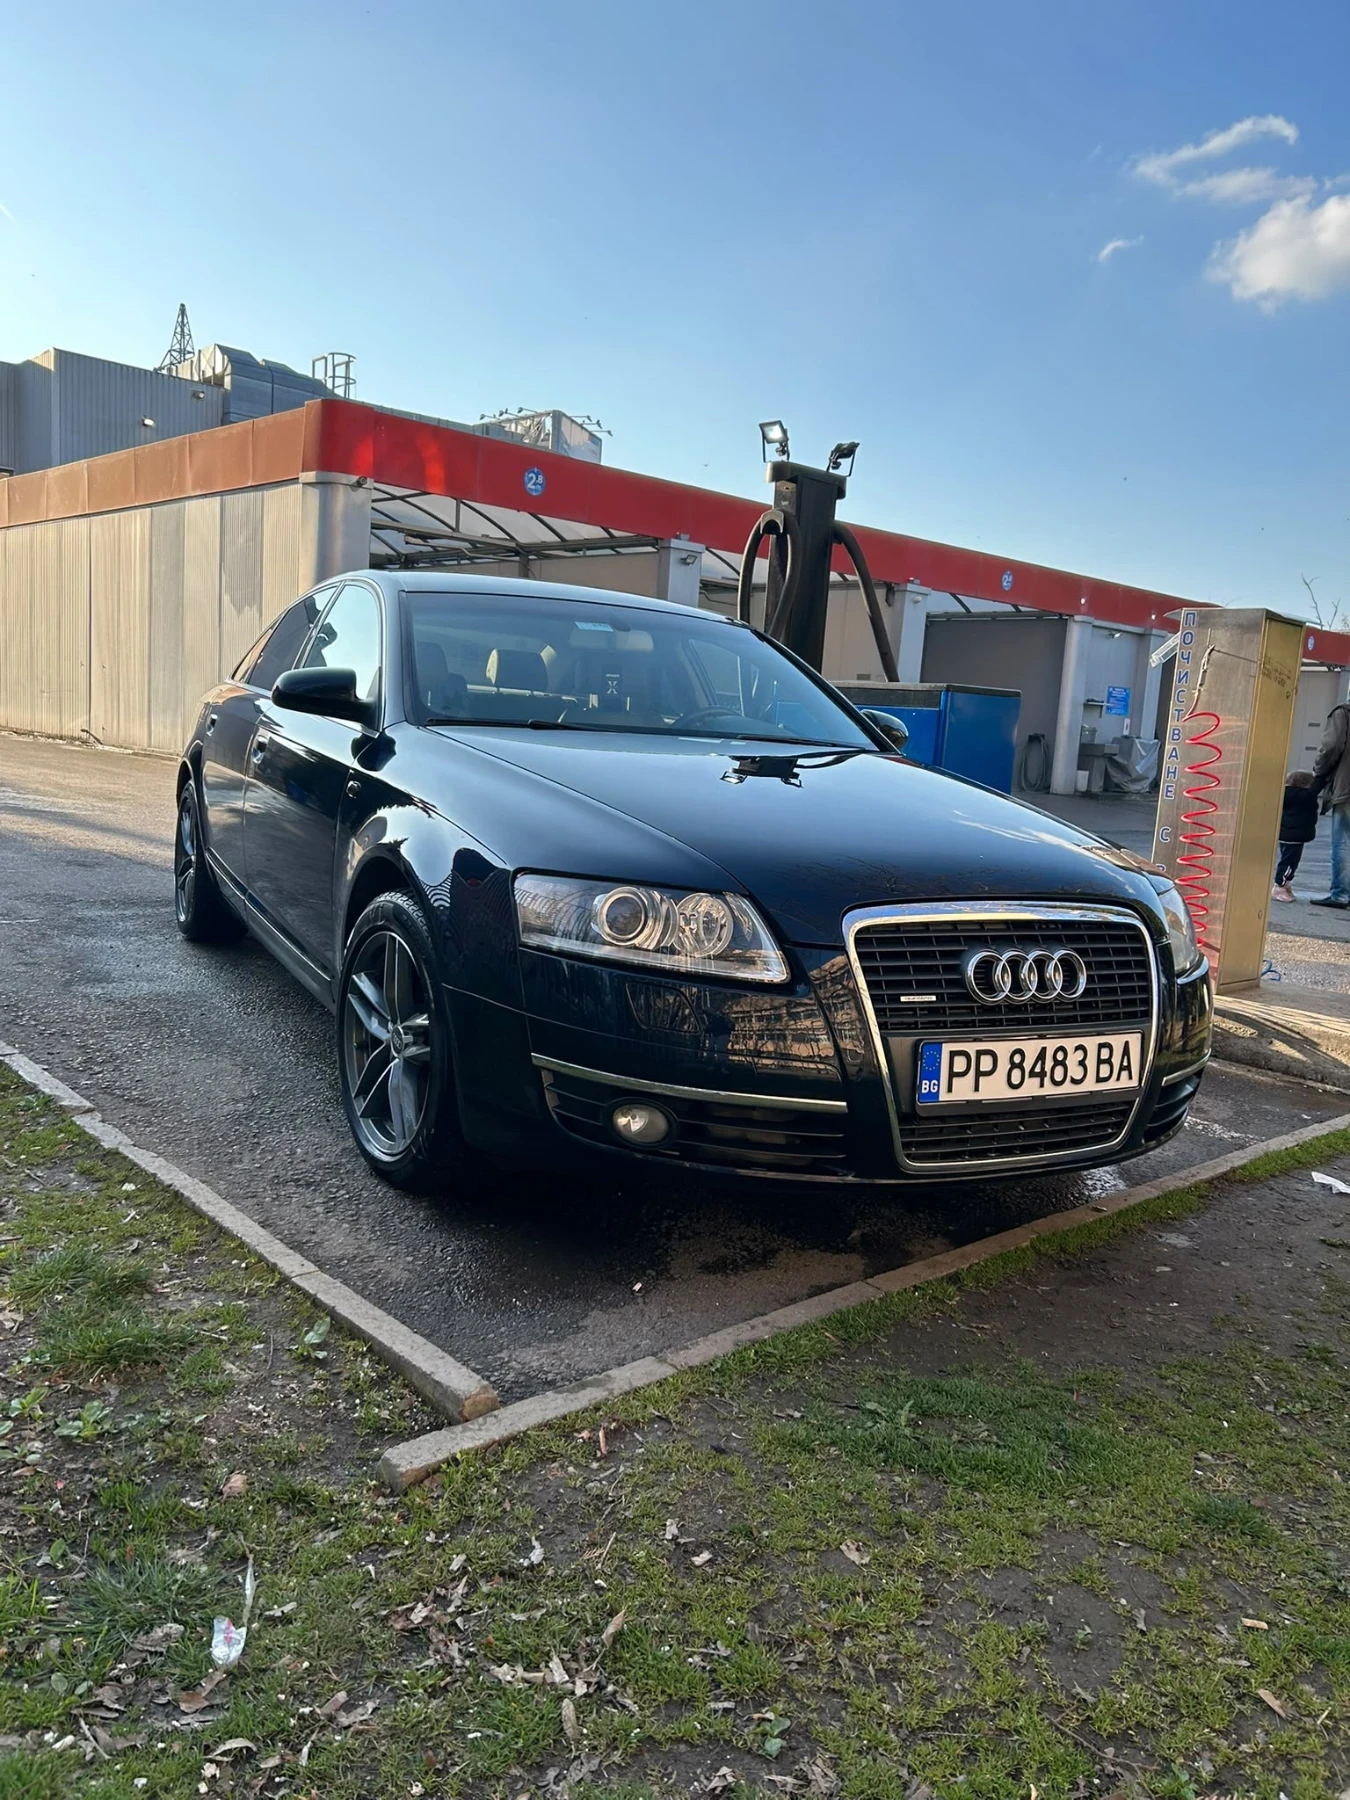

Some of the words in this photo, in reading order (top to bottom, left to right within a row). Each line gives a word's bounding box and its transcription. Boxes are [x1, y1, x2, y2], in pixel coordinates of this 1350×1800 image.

[1164, 611, 1197, 799] ПОЧИСТВАНЕ
[921, 1080, 938, 1093] BG
[947, 1049, 998, 1093] PP
[1006, 1044, 1088, 1090] 8483
[1096, 1040, 1133, 1083] BA
